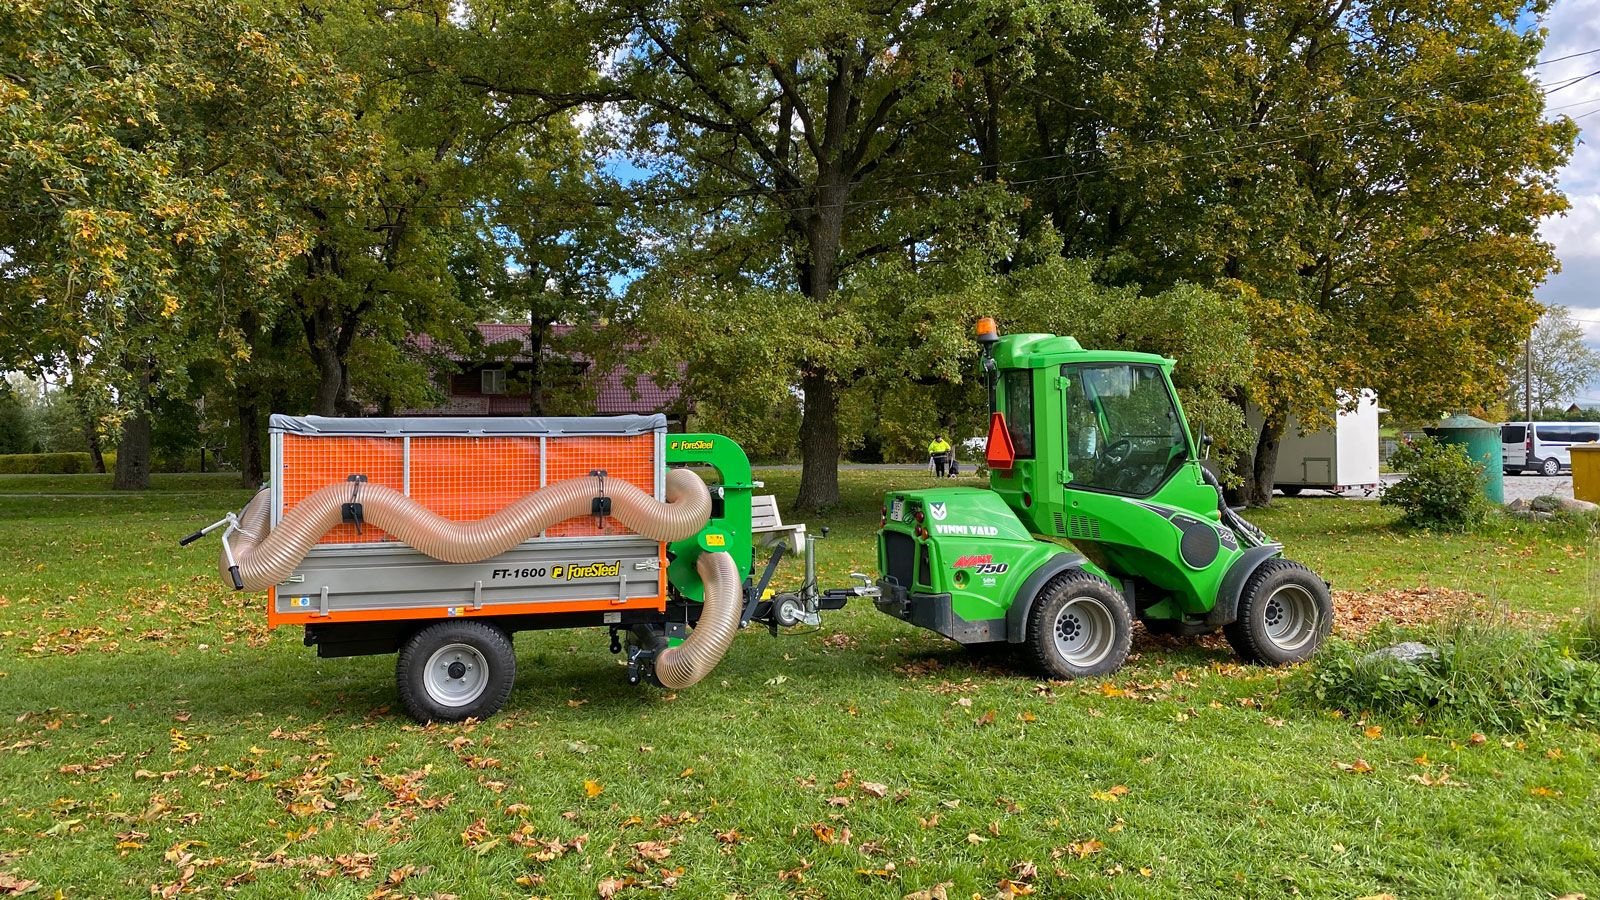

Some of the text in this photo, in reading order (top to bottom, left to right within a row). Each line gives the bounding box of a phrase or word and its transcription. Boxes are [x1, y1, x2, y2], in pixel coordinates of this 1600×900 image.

[935, 525, 998, 536] VINNI VALD
[492, 568, 546, 579] FT-1600
[976, 563, 1009, 574] 750
